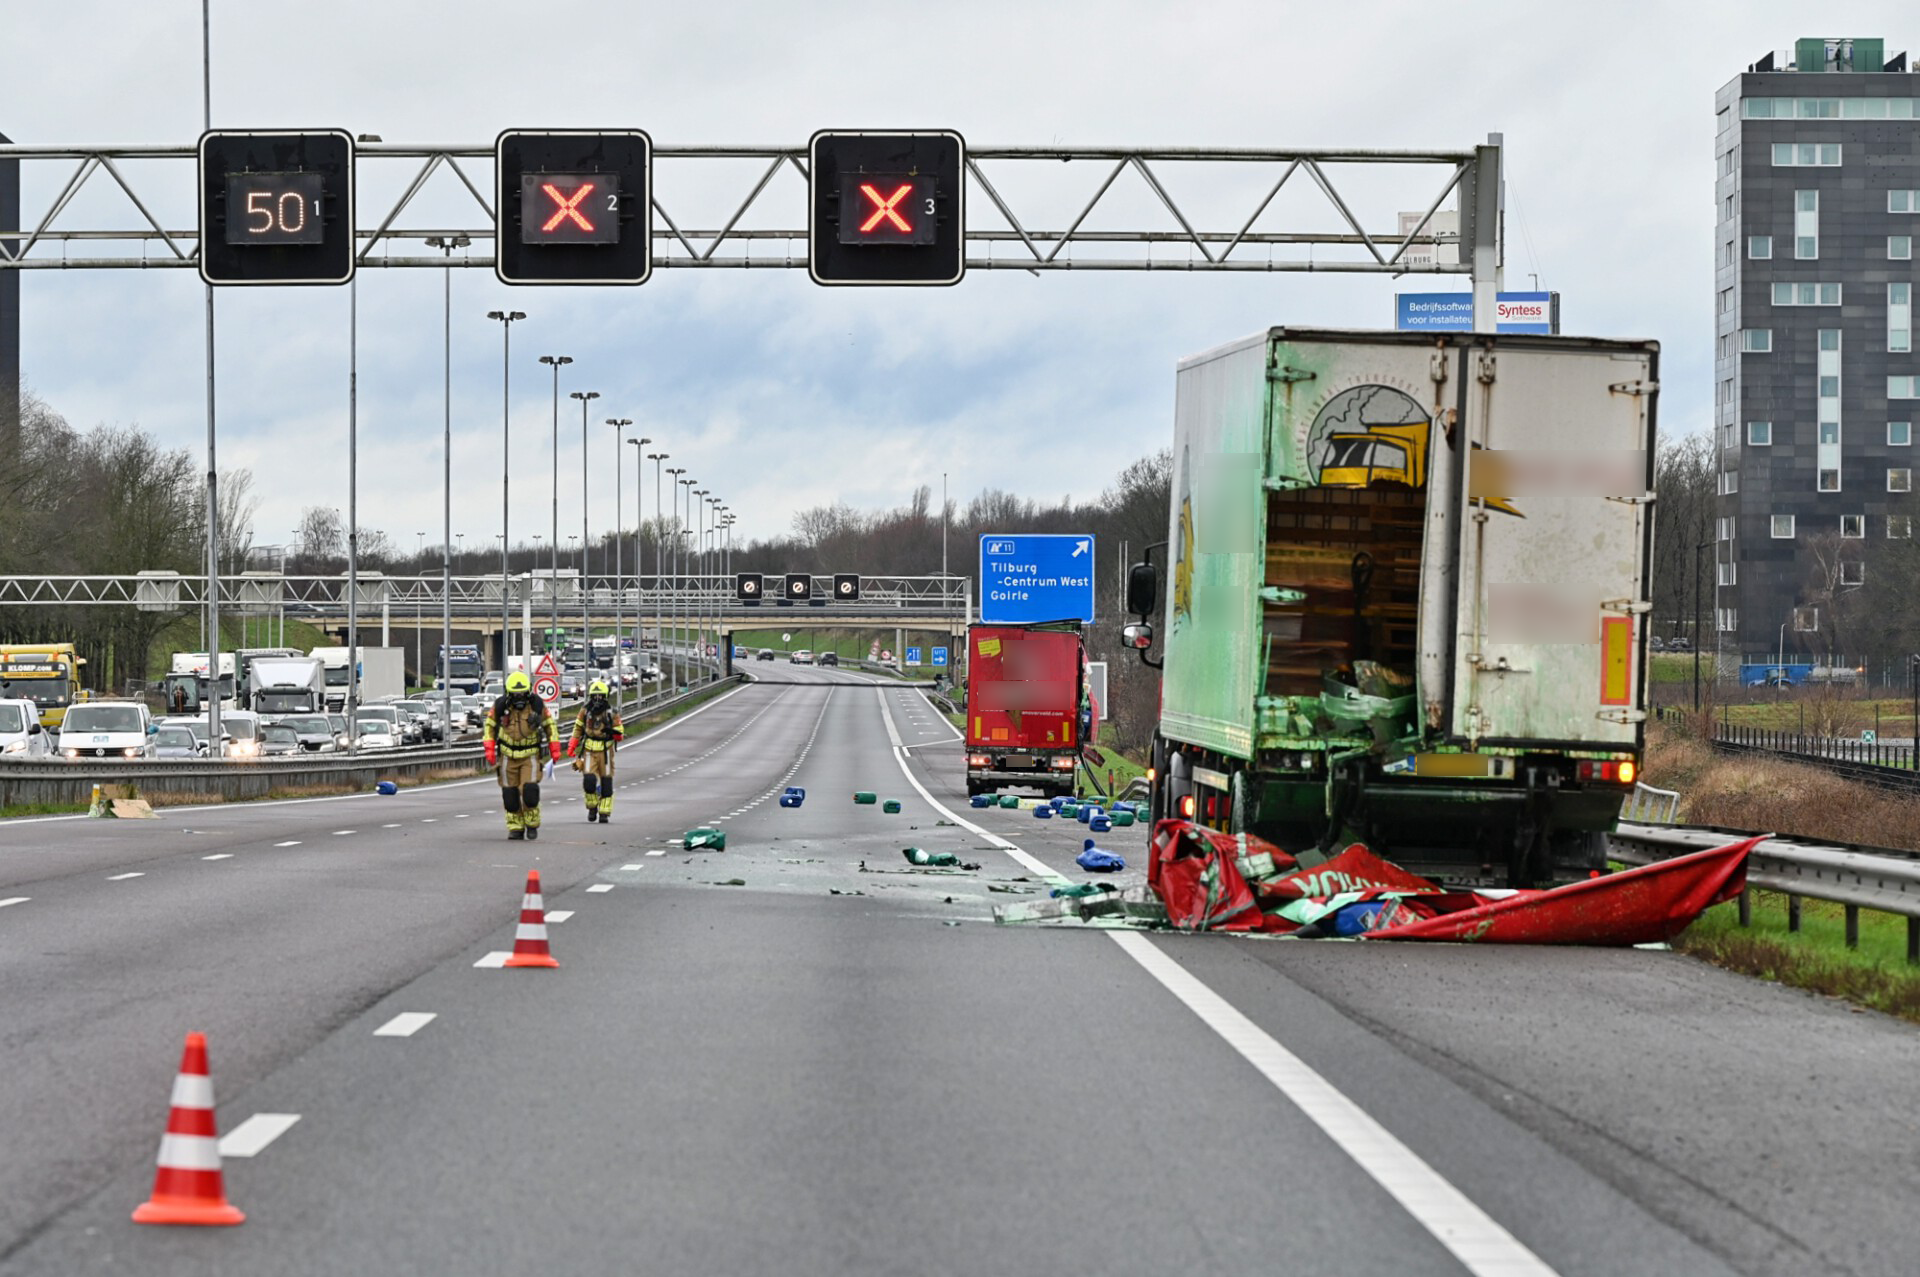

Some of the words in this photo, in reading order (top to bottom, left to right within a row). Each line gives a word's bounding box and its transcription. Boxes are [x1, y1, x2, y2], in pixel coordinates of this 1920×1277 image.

[313, 200, 320, 216] 1
[607, 194, 618, 211] 2
[924, 198, 935, 215] 3
[247, 192, 304, 233] 50
[1497, 304, 1542, 318] Syntess
[1407, 316, 1427, 325] voor
[1295, 384, 1341, 478] NTERNATIONAAL
[1004, 544, 1012, 552] 11
[990, 562, 1037, 575] Tilburg
[997, 576, 1057, 587] -Centrum
[1060, 576, 1089, 587] West
[990, 590, 1029, 601] Goirle
[538, 684, 555, 696] 90
[1443, 876, 1495, 887] DAF
